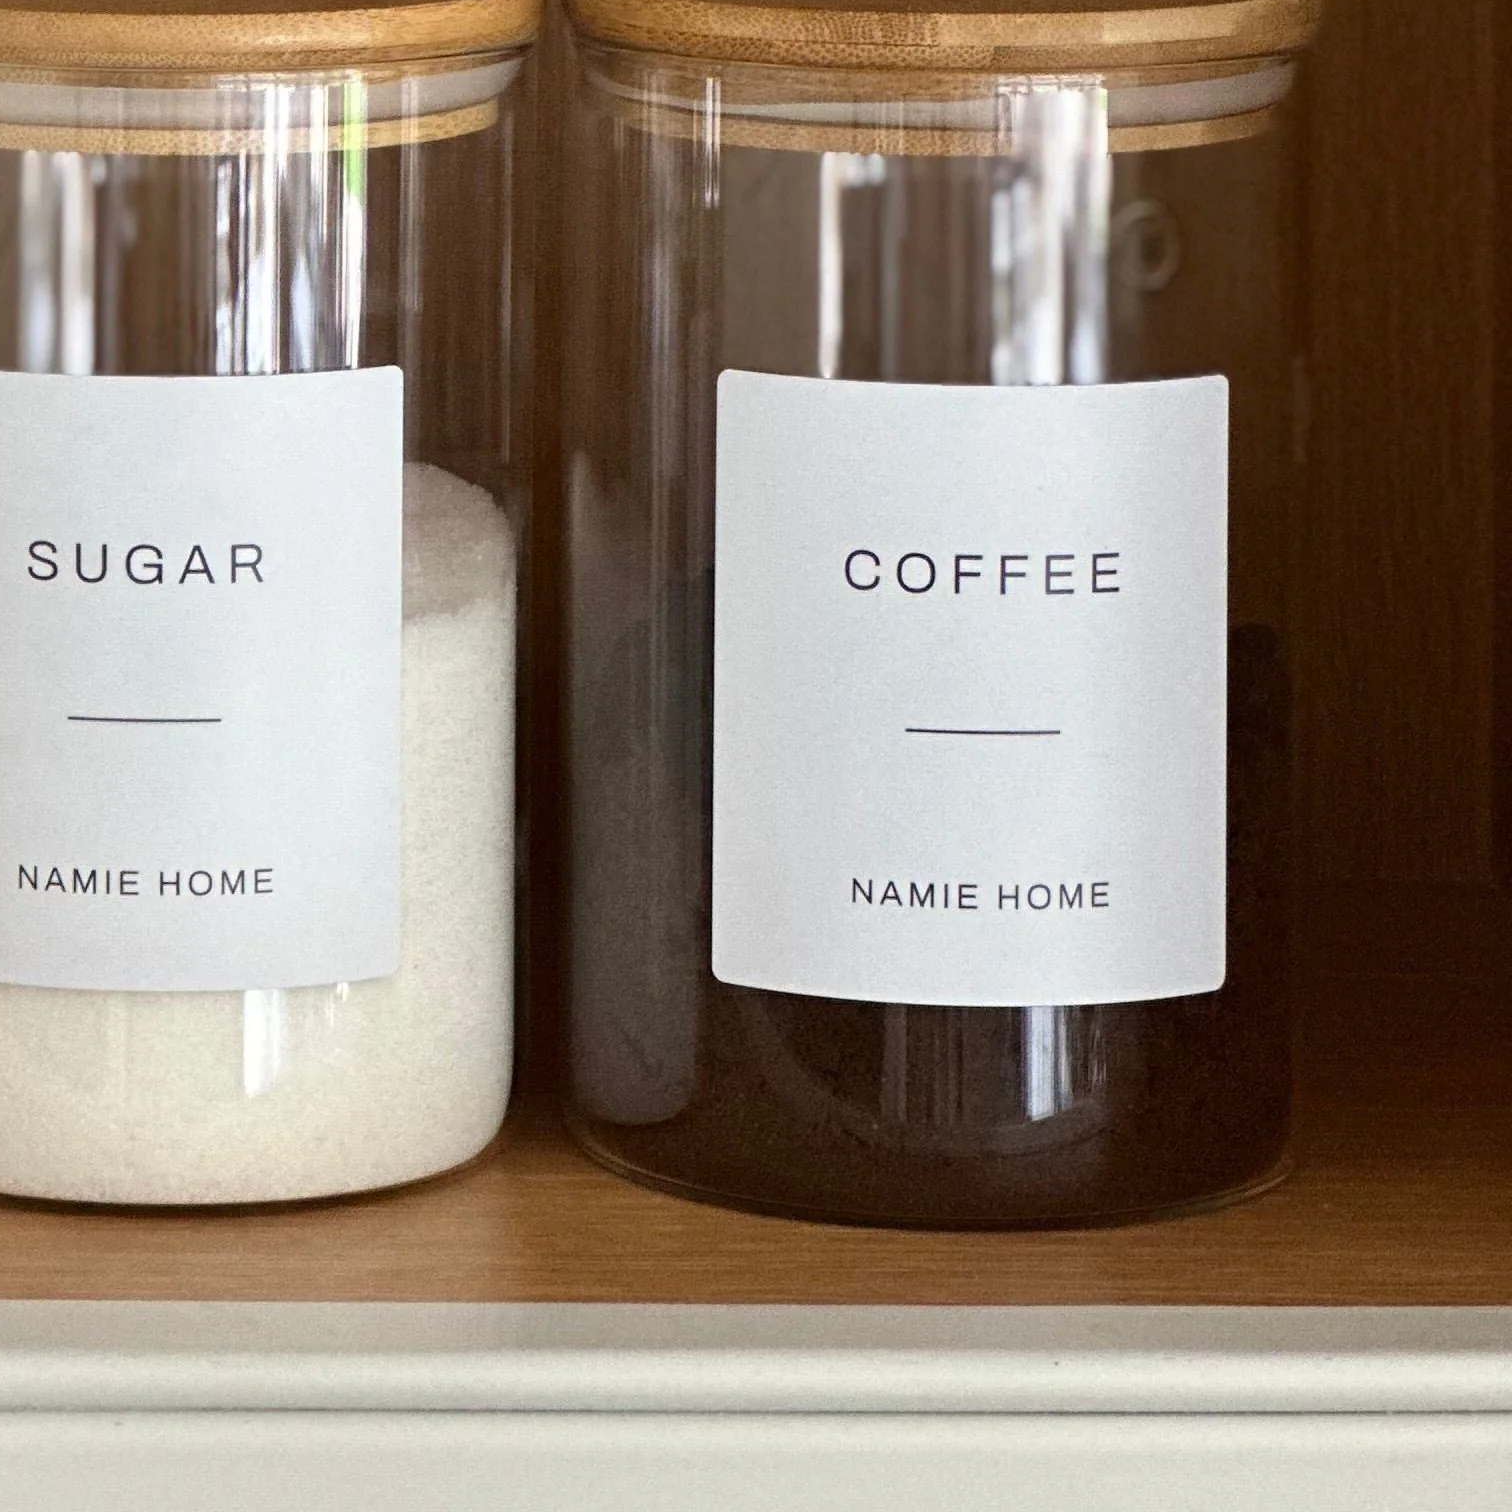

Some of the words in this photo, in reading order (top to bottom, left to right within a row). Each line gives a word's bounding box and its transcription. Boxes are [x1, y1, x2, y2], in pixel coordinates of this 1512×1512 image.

[27, 539, 265, 585] SUGAR
[844, 548, 1121, 596] COFFEE
[17, 863, 140, 897] NAMIE
[159, 867, 274, 897] HOME
[851, 877, 979, 910] NAMIE
[997, 880, 1110, 911] HOME
